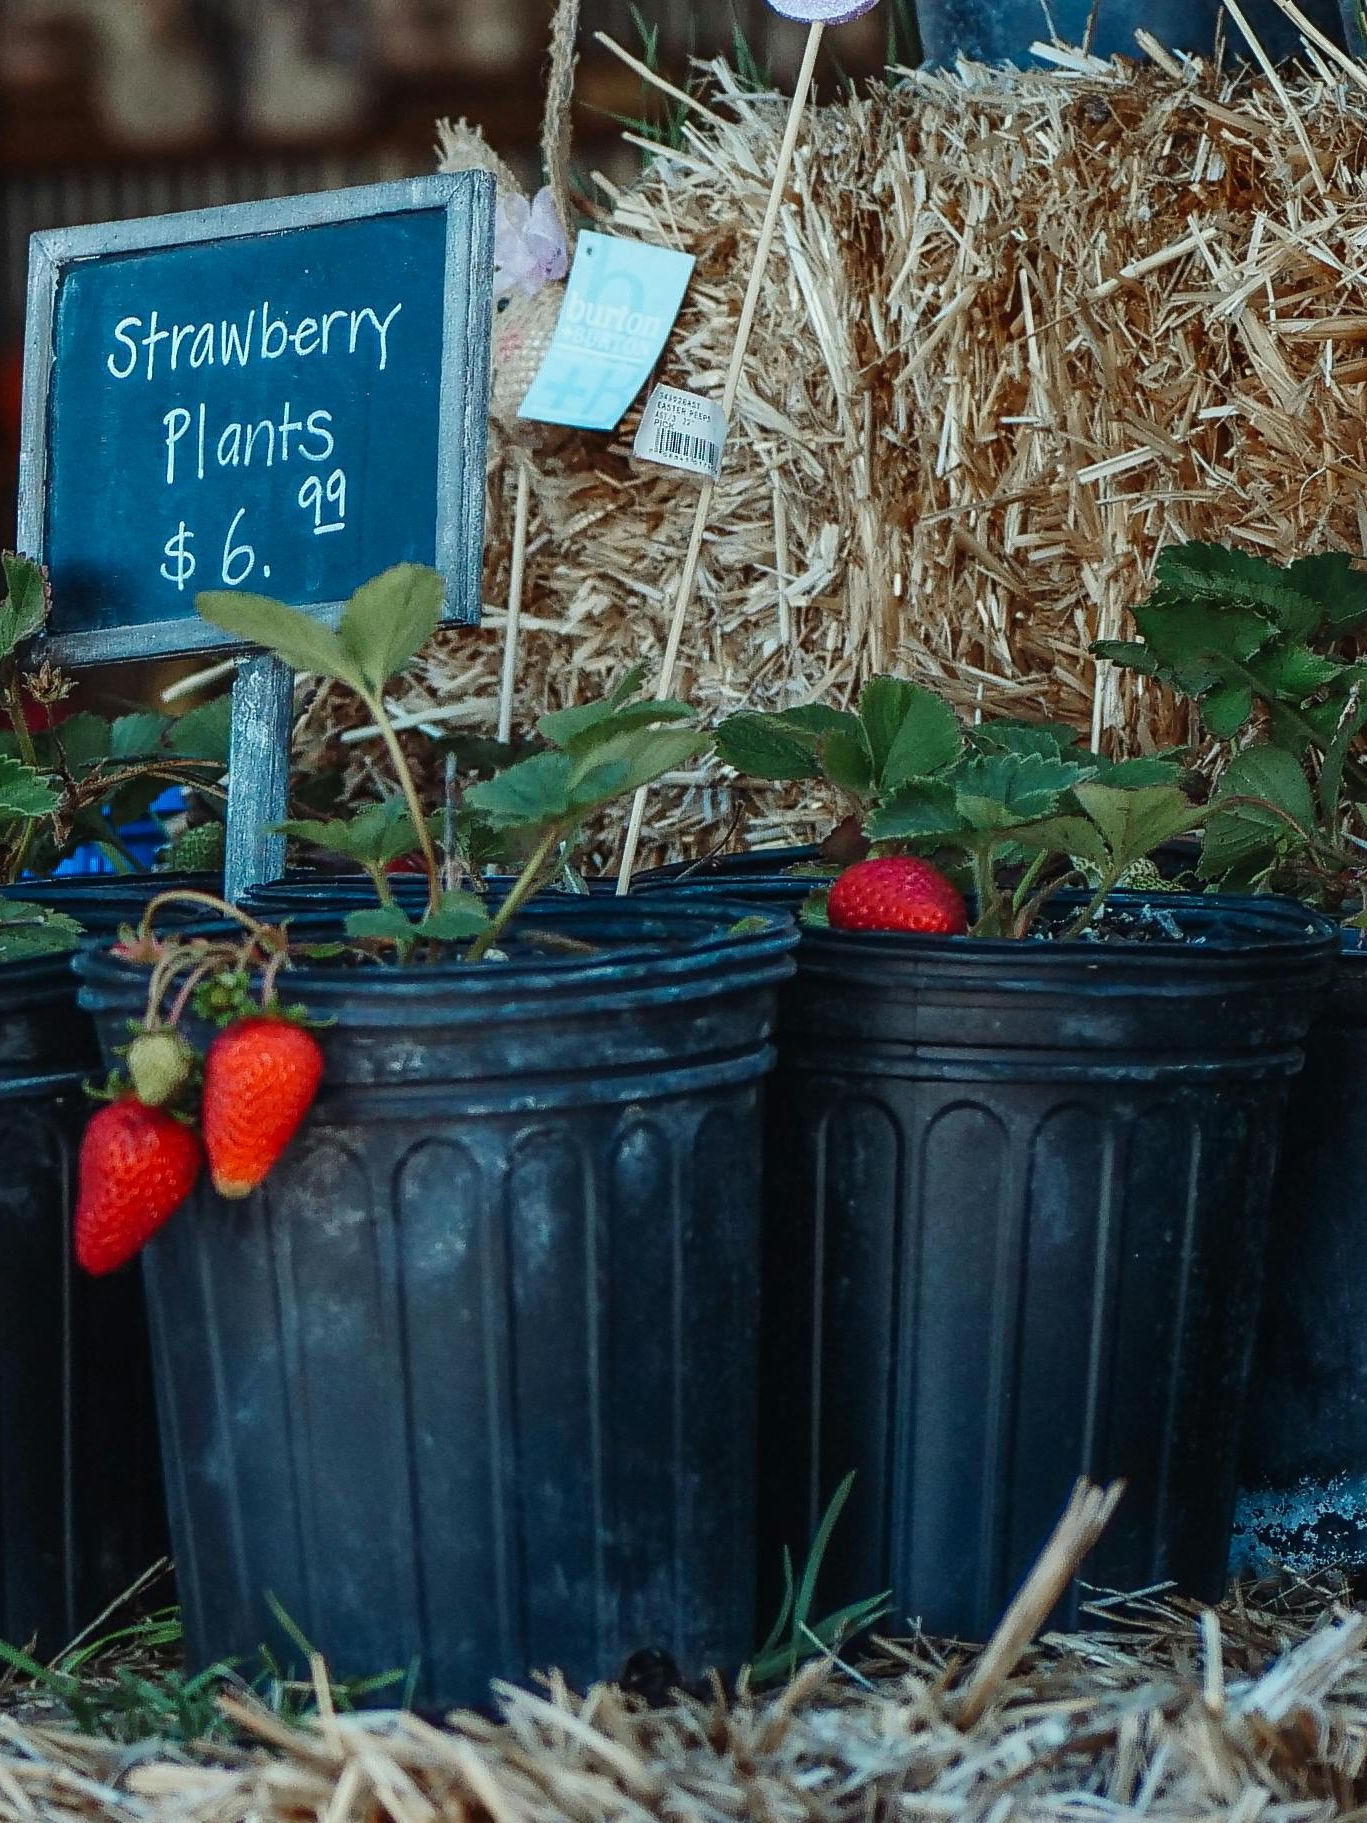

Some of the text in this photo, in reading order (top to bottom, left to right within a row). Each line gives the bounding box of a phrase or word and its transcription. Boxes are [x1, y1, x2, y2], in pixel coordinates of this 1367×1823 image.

[566, 289, 662, 337] burton
[106, 301, 403, 381] Strawberry
[653, 418, 675, 430] PICK
[657, 401, 687, 416] EASTER
[162, 401, 335, 484] Plants
